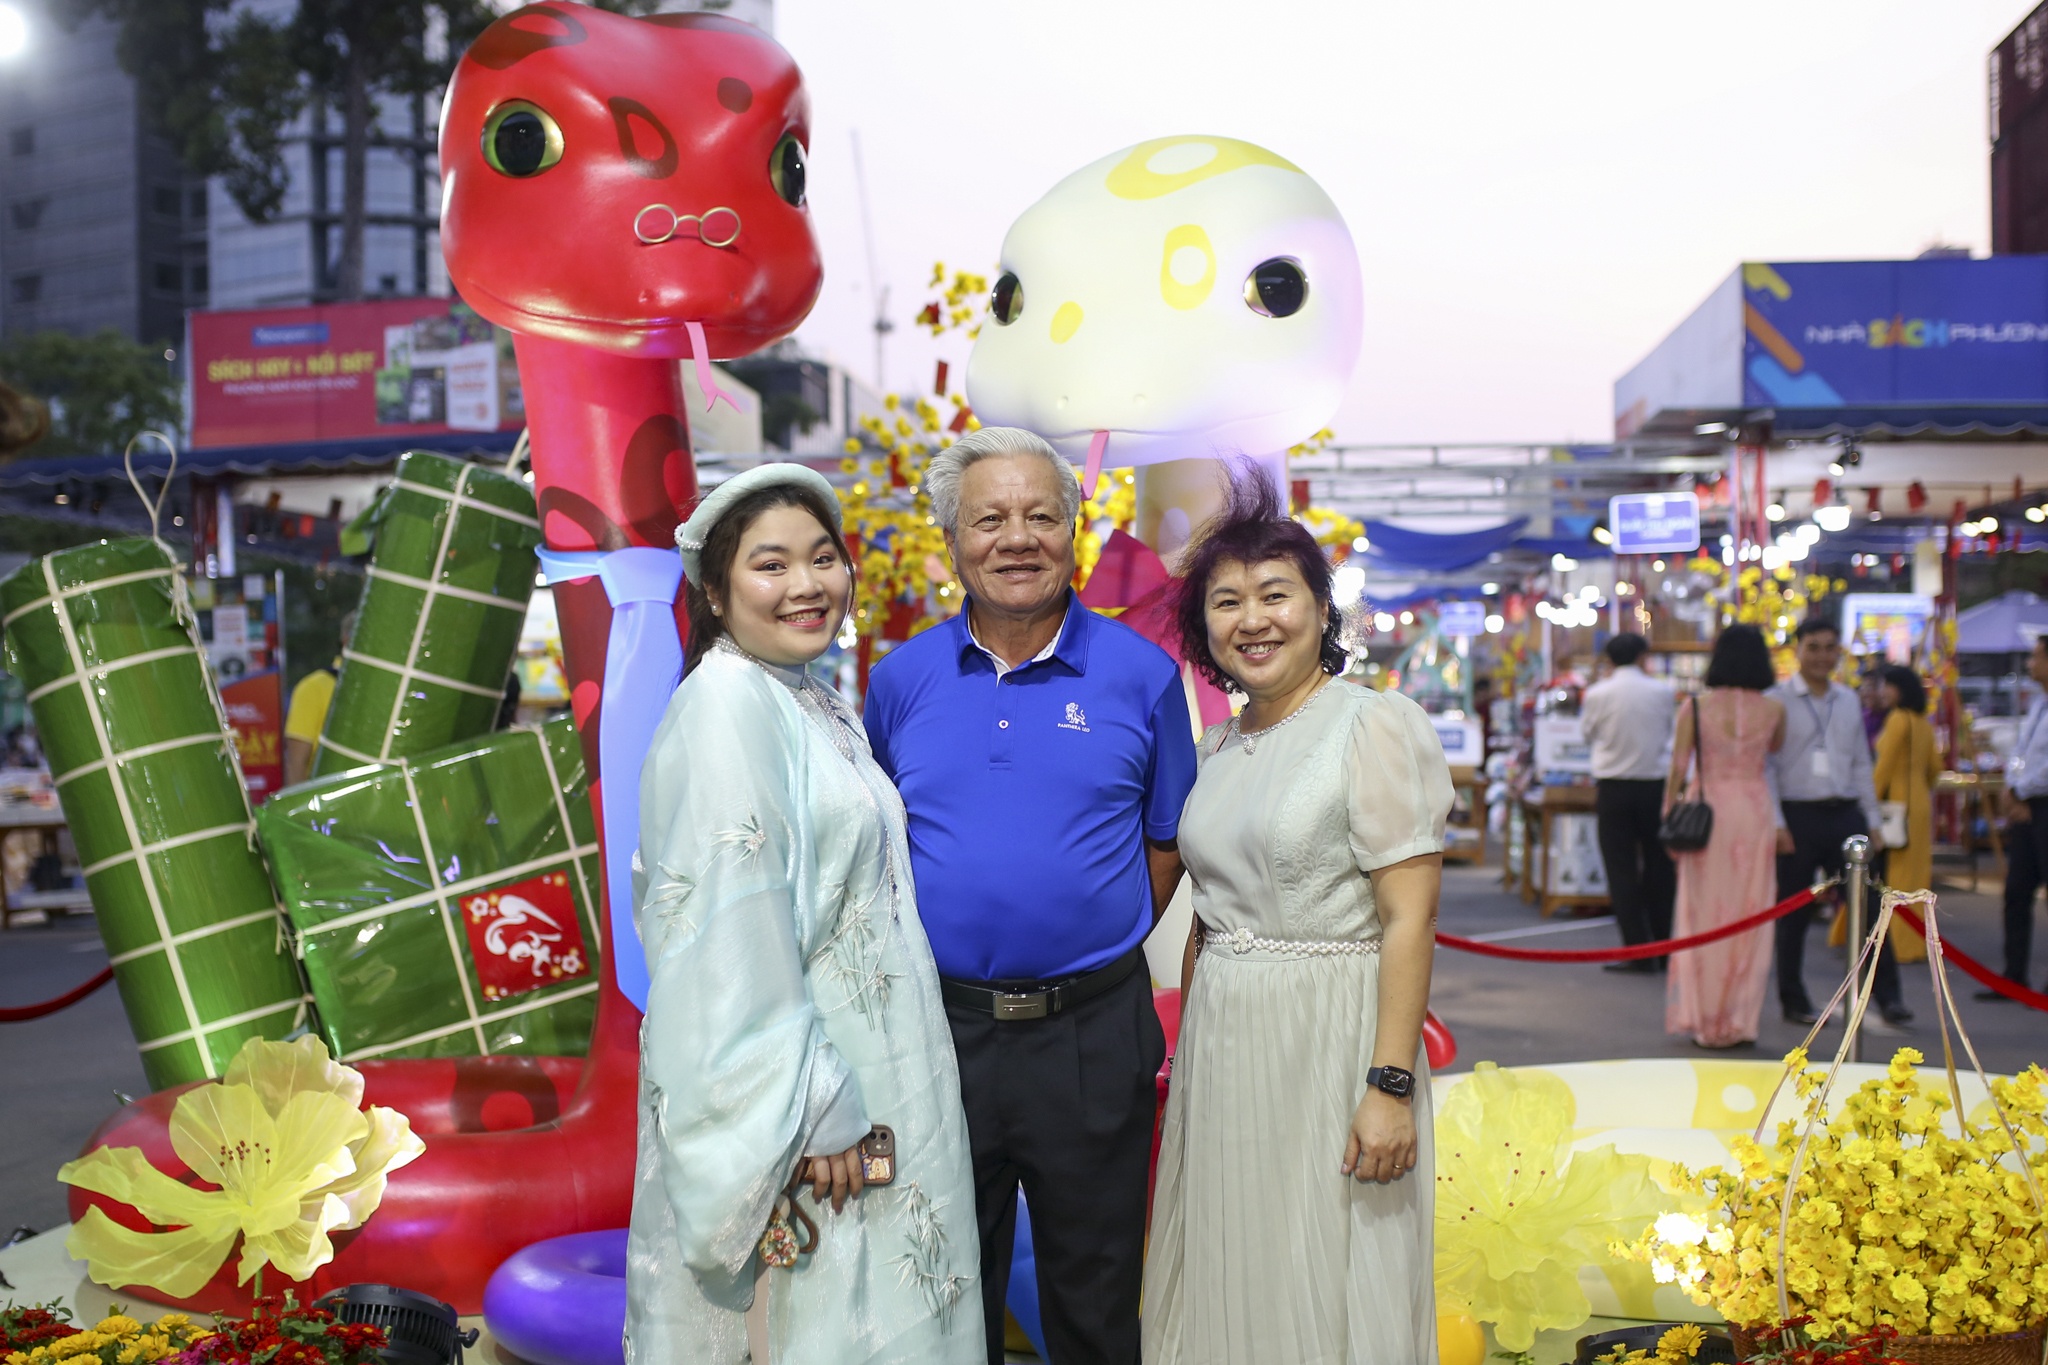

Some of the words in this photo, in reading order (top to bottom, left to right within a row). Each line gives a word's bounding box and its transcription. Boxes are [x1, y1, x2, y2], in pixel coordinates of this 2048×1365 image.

[1805, 320, 1866, 344] NHÀ
[1869, 313, 1949, 348] SÁCH
[1057, 723, 1081, 731] PANTHERA
